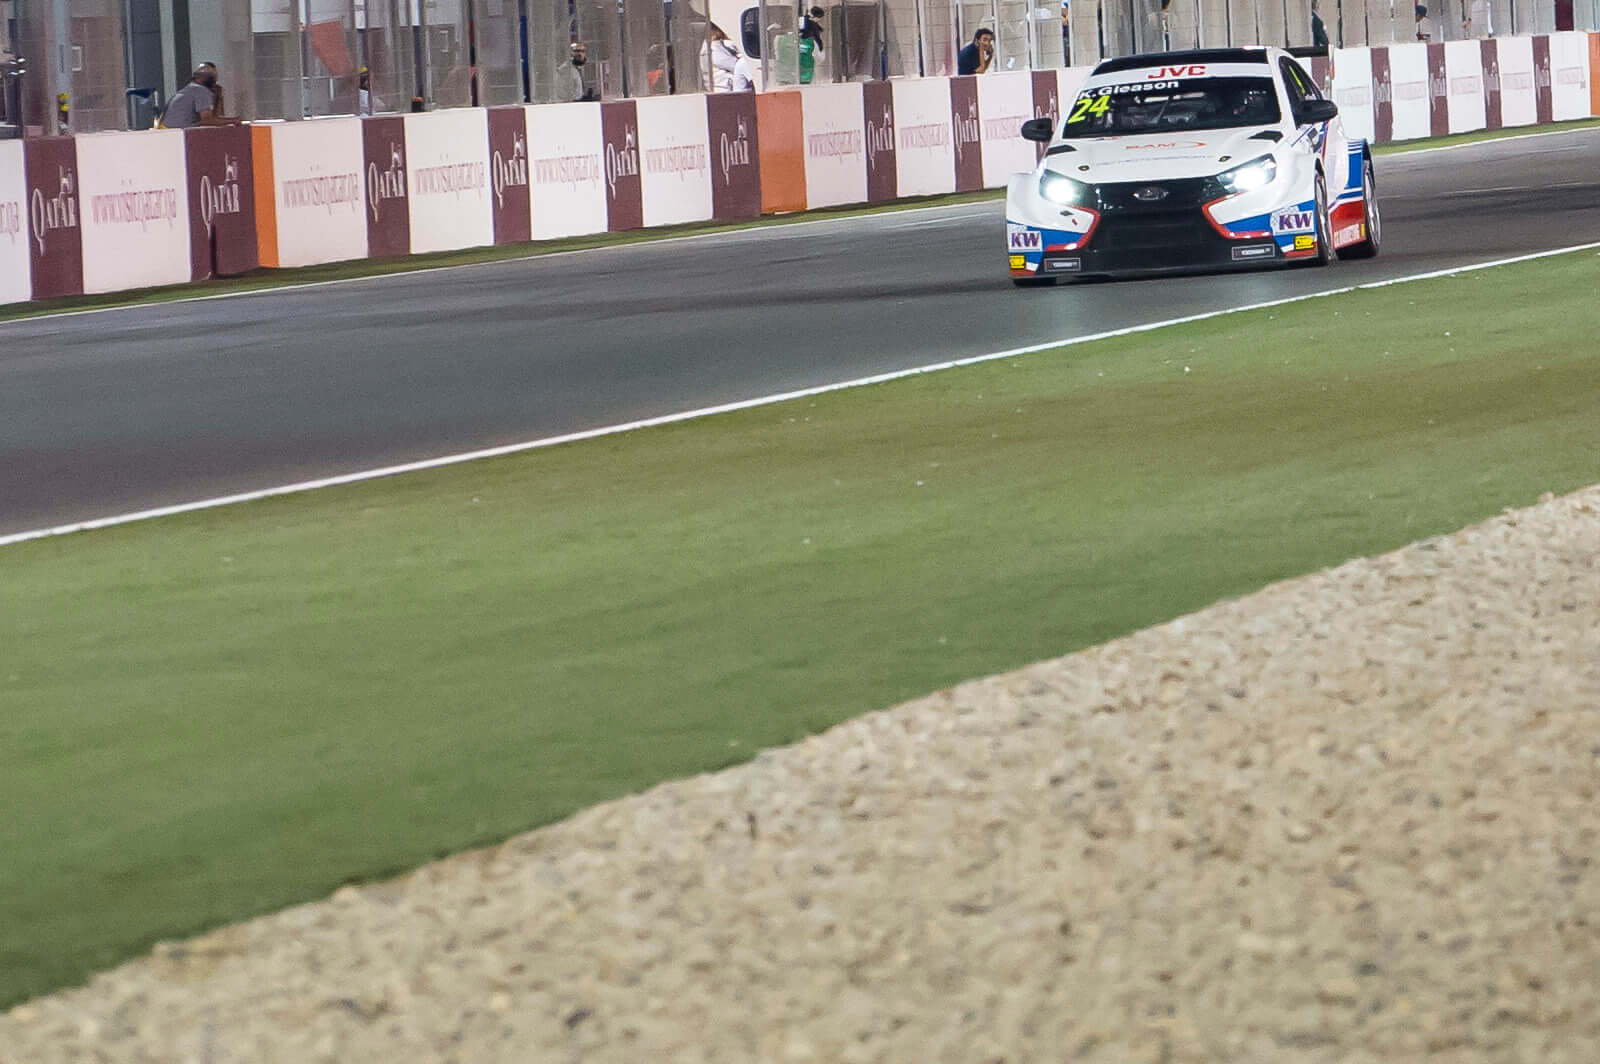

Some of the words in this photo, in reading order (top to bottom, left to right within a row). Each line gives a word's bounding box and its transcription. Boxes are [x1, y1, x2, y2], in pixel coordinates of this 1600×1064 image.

[1147, 65, 1207, 80] JVC
[1067, 94, 1111, 125] 24
[1278, 212, 1313, 231] KW
[1010, 231, 1040, 248] KW
